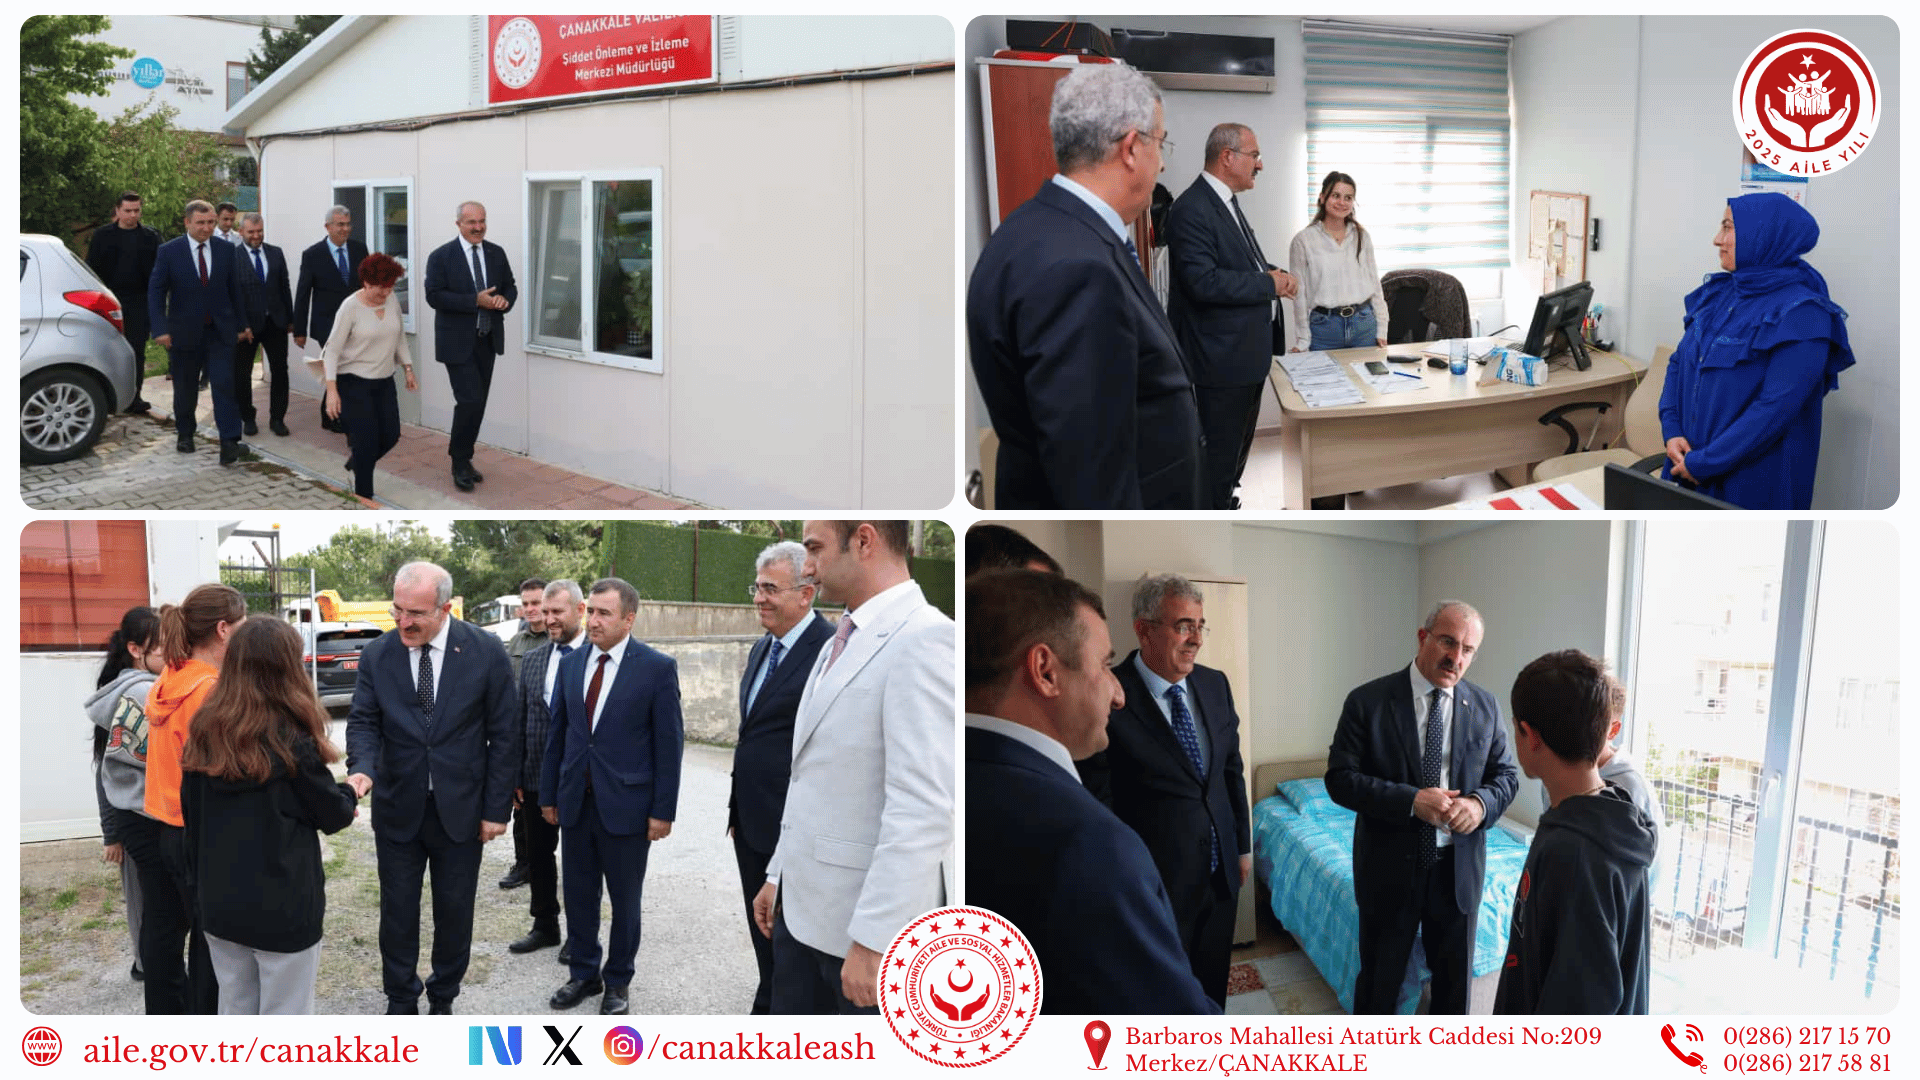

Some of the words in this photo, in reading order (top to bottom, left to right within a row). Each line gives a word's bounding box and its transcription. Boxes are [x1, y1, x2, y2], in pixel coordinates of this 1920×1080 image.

[558, 15, 632, 39] ÇANAKKALE
[562, 51, 594, 66] Şiddet
[595, 45, 634, 60] Önleme
[636, 43, 649, 54] ve
[651, 36, 690, 51] İzleme
[575, 65, 614, 81] Merkezi
[616, 56, 676, 76] Müdürlüğü
